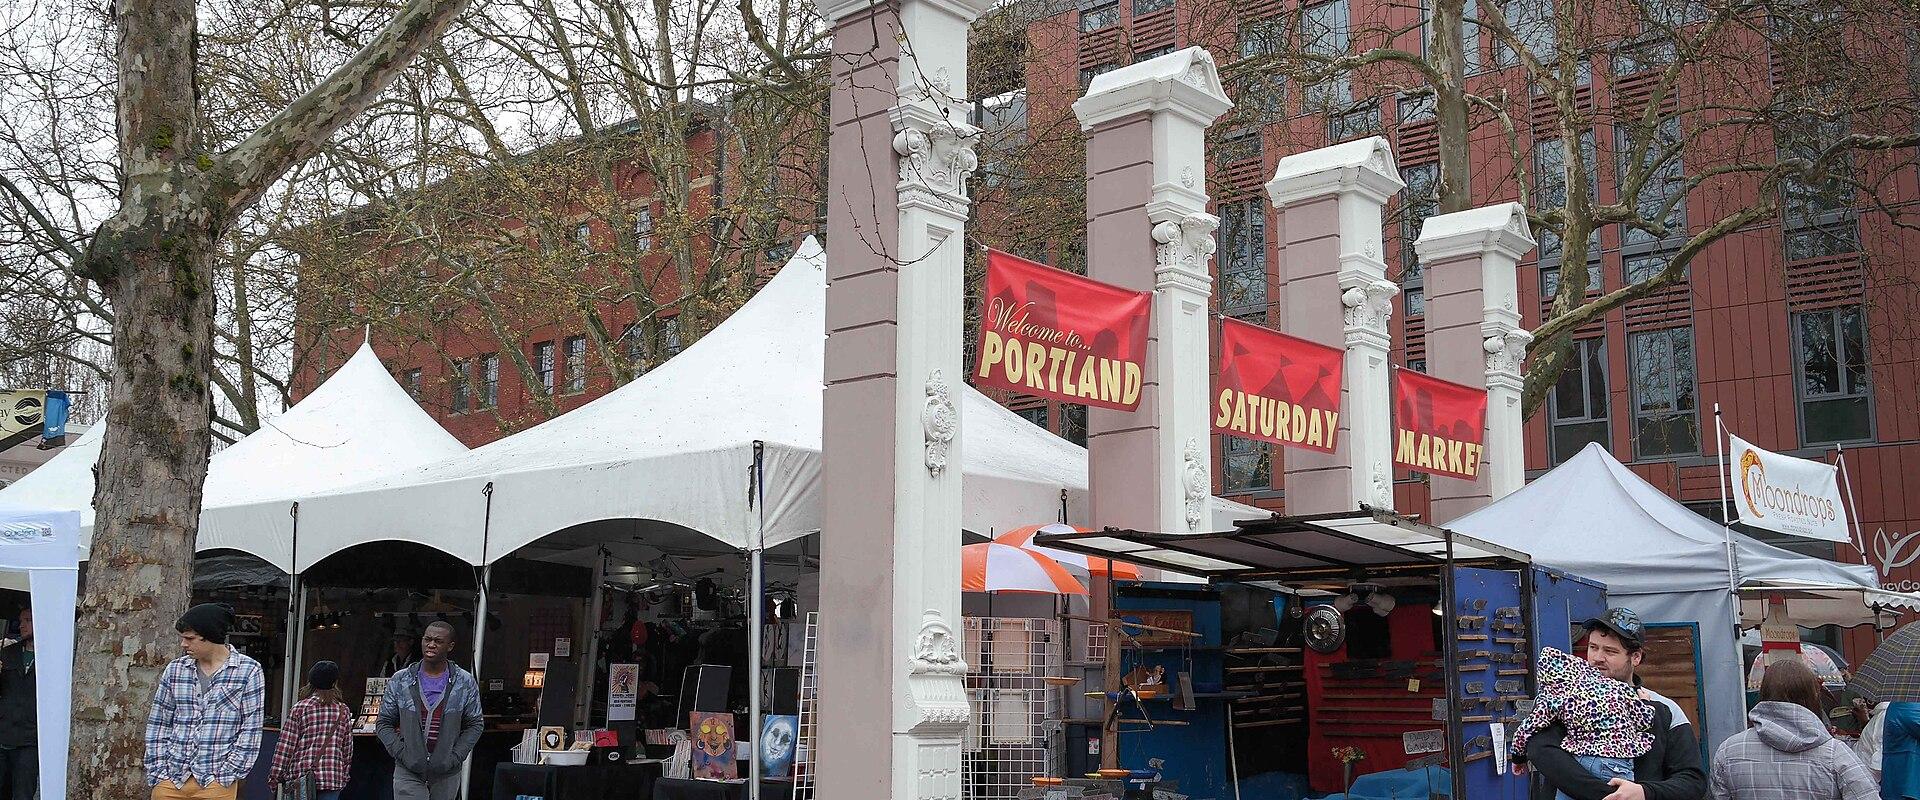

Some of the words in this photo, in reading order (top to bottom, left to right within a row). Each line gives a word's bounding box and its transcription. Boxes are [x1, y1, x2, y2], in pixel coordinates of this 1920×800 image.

[988, 297, 1064, 345] Welcome
[1064, 328, 1091, 351] to...
[979, 330, 1141, 405] PORTLAND
[1215, 389, 1338, 449] SATURDAY
[1395, 429, 1484, 477] MARKET
[1751, 471, 1835, 527] Moondrops
